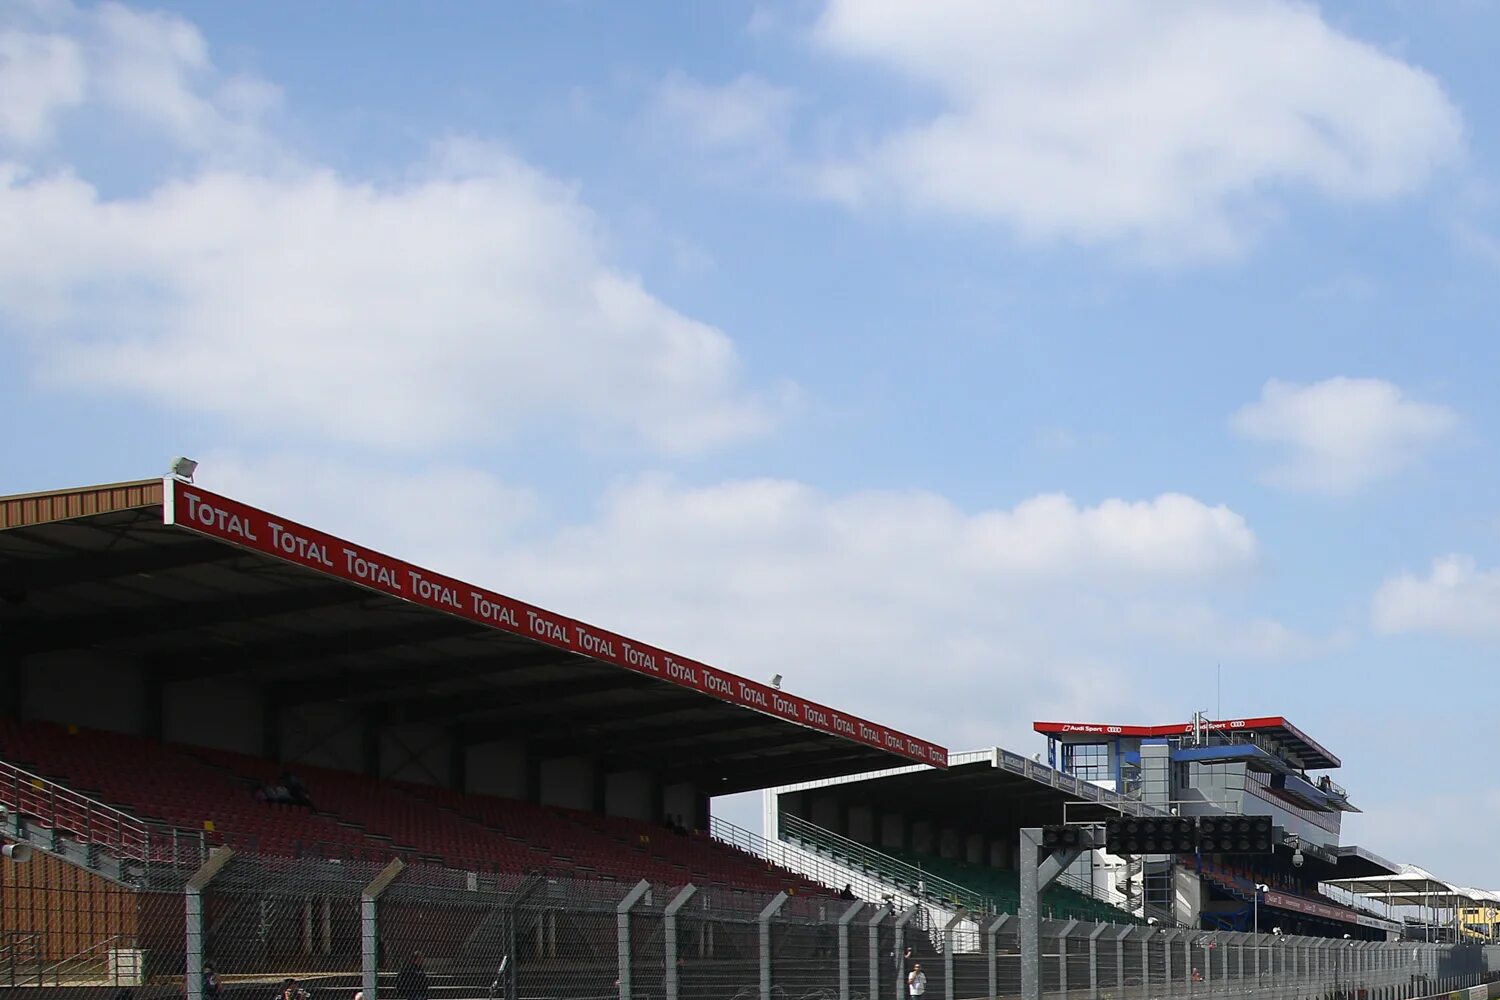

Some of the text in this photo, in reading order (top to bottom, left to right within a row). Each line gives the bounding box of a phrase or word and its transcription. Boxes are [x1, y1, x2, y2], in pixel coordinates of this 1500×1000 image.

[184, 492, 946, 765] TOTAL TOTAL TOTAL TOTAL TOTAL TOTAL TOTAL TOTAL TOTAL TOTAL TOTAL TOTAL TOTAL TOTAL TOTAL TOTAL TOTAL TOTAL
